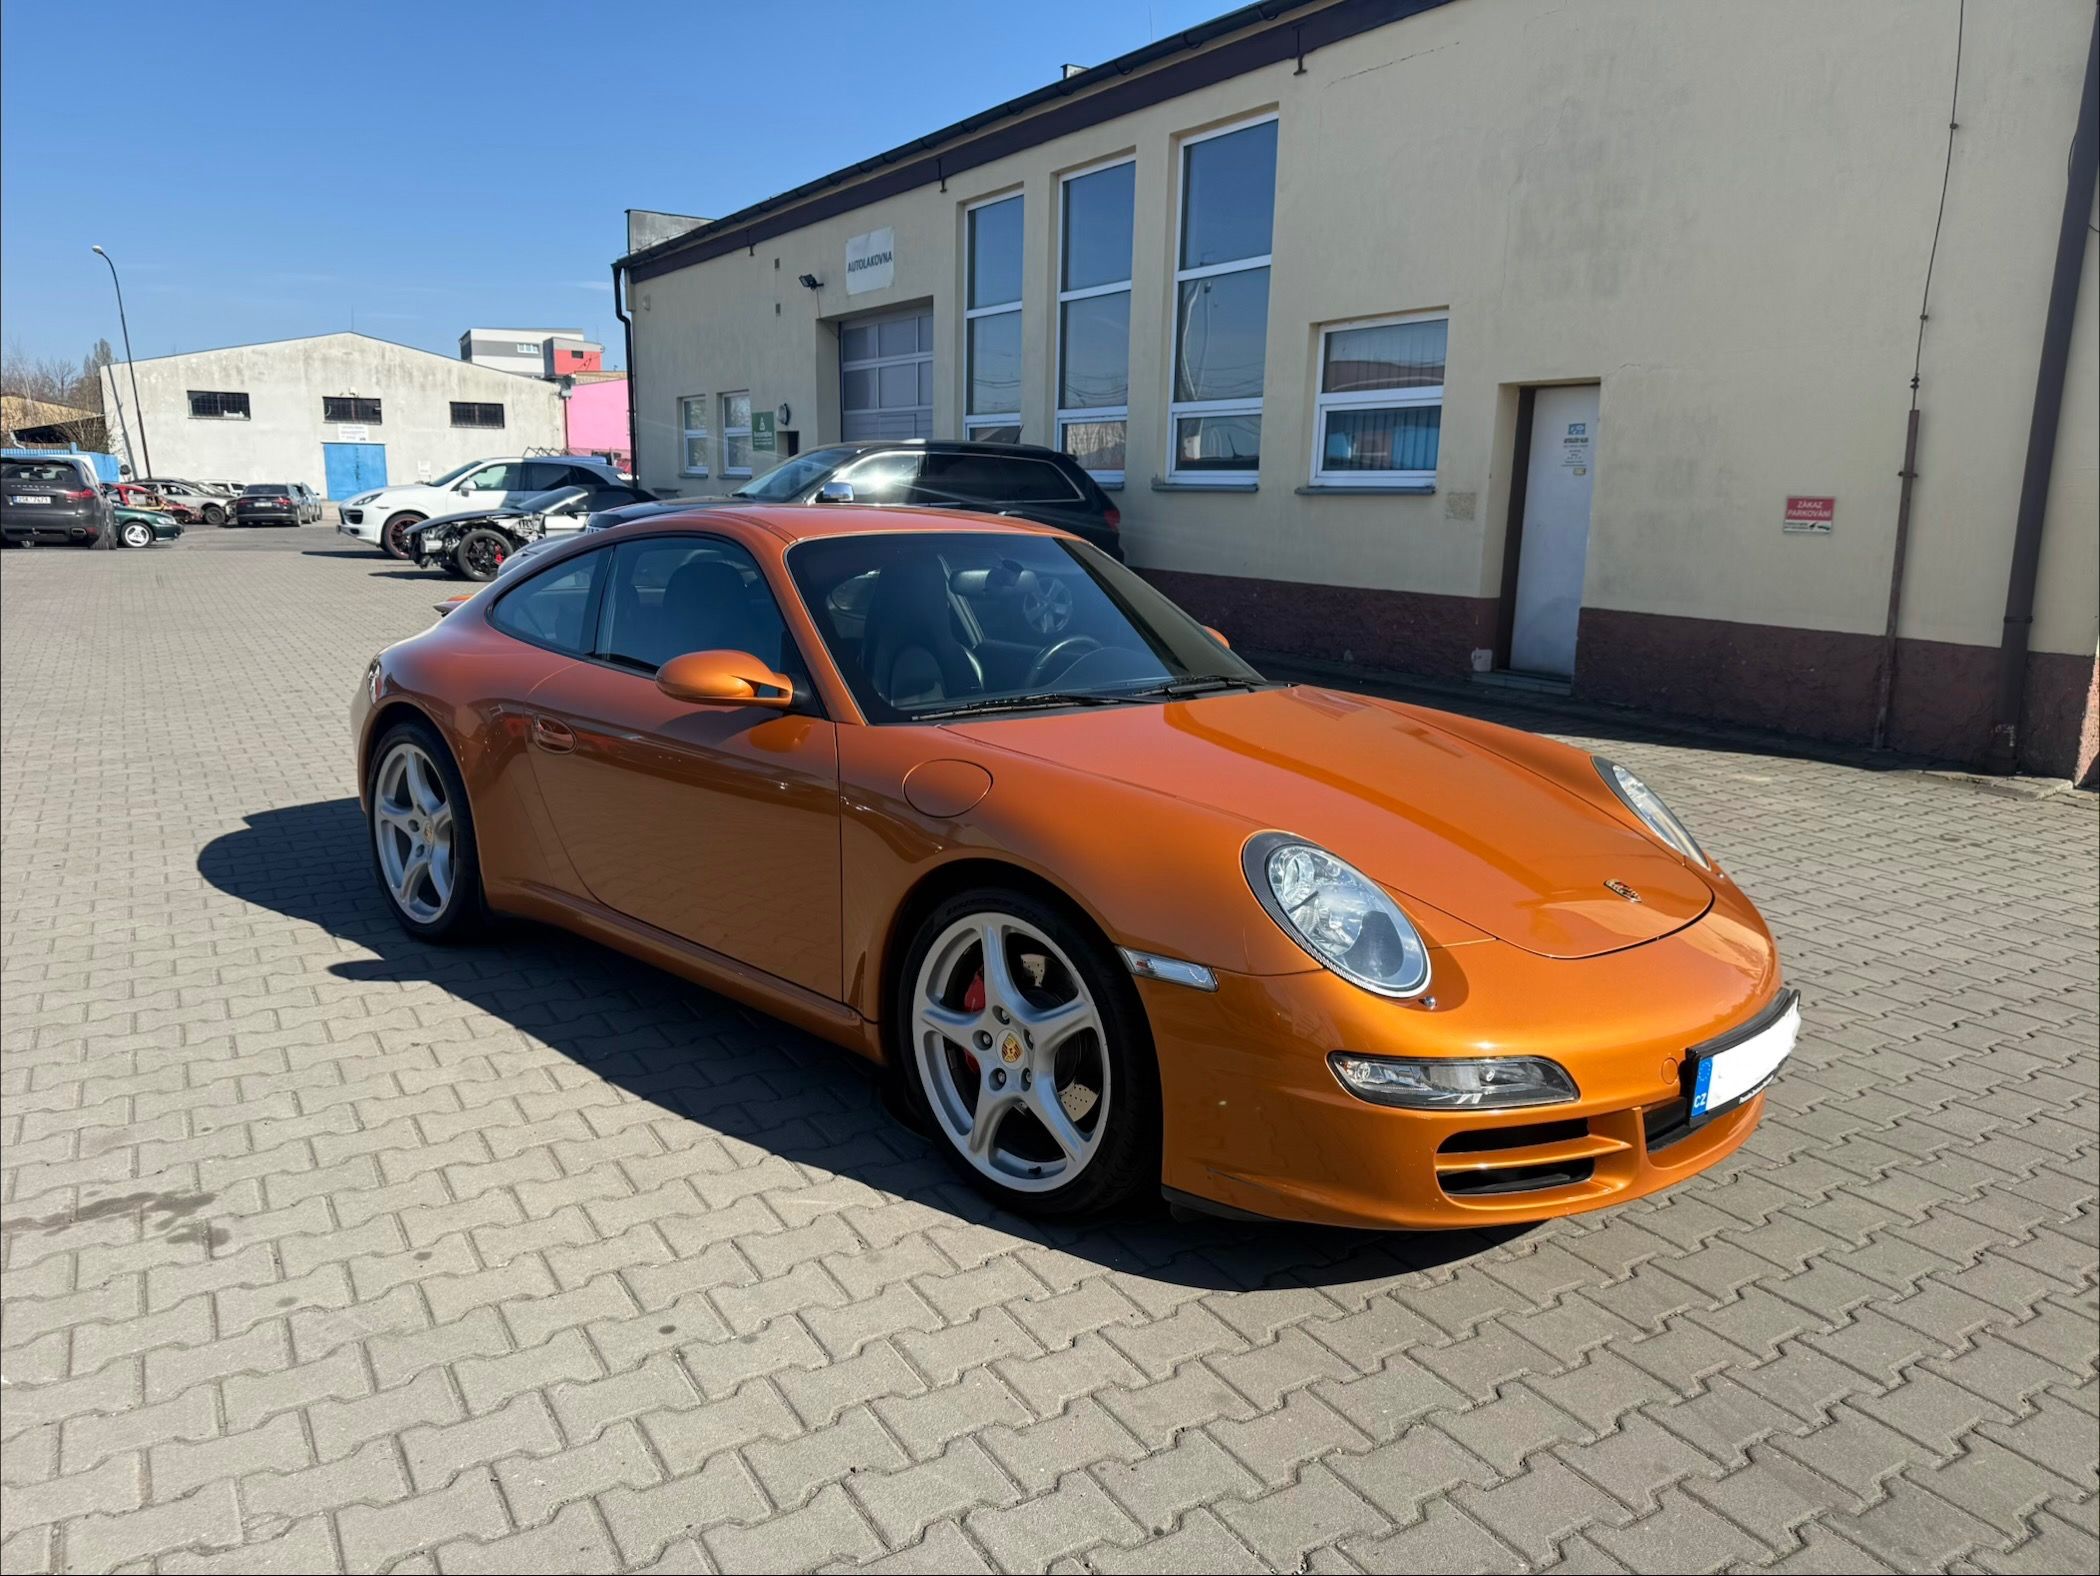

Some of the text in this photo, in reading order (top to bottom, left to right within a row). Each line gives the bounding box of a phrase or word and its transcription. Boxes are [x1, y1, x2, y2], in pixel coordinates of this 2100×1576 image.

[848, 251, 892, 273] AUTOLAKOVNA
[1797, 500, 1824, 509] ZÁKAZ
[1694, 1092, 1707, 1107] CZ
